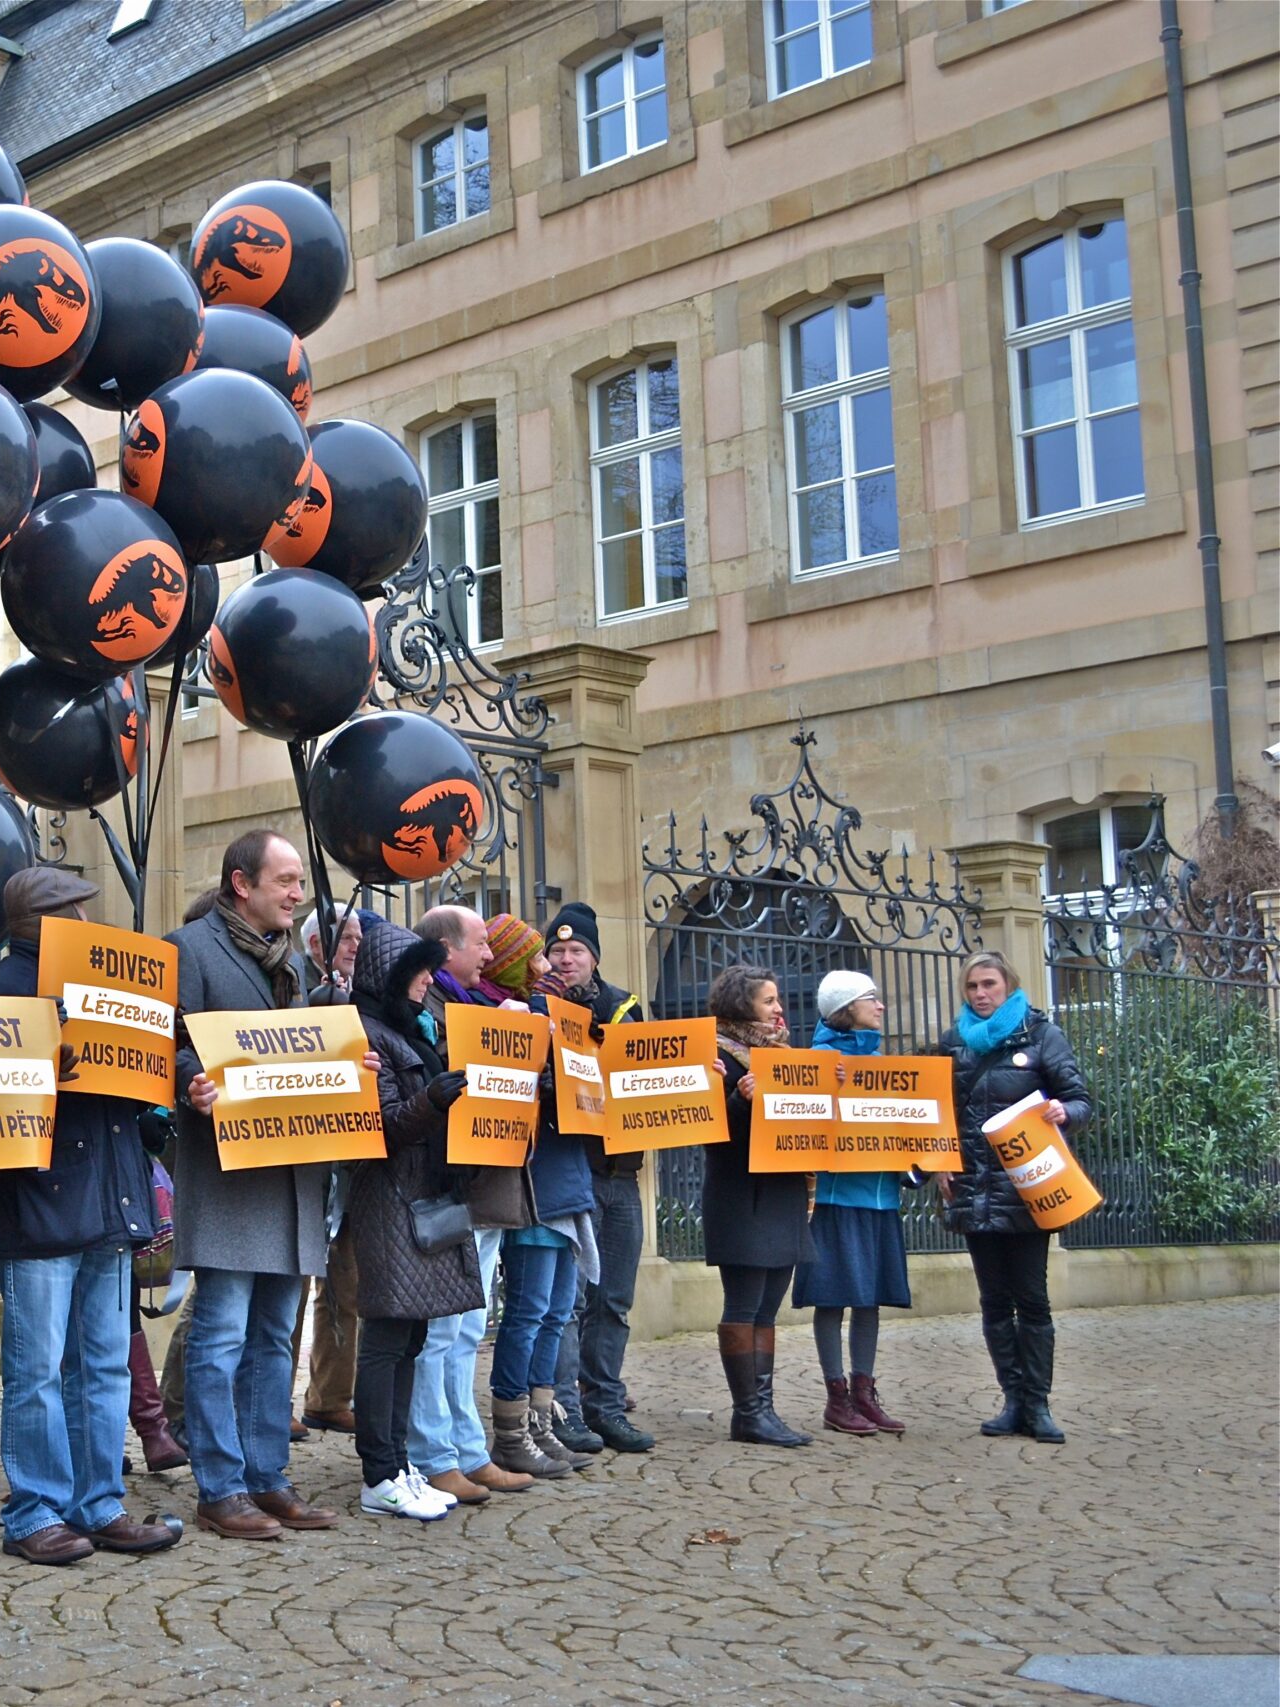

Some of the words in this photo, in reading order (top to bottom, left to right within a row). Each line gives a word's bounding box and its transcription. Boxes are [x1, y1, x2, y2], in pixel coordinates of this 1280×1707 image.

[89, 945, 165, 990] #DIVEST
[81, 992, 170, 1029] LËTZEBUERG
[235, 1026, 326, 1055] #DIVEST
[481, 1027, 533, 1060] #DIVEST
[625, 1036, 688, 1061] #DIVEST
[80, 1041, 114, 1066] AUS
[117, 1046, 143, 1072] DER
[146, 1052, 168, 1079] KUEL
[243, 1070, 346, 1092] LËTZEBUERG
[478, 1071, 533, 1096] LËTZEBUERG
[622, 1074, 696, 1091] LËTZEBUERG
[773, 1064, 819, 1086] #DIVEST
[853, 1070, 919, 1091] #DIVEST
[623, 1112, 644, 1130] AUS
[645, 1109, 670, 1127] DEM
[671, 1104, 714, 1125] PËTROL
[774, 1098, 826, 1114] LËTZEBUERG
[852, 1101, 927, 1118] LËTZEBUERG
[6, 1109, 55, 1139] PËTRO
[218, 1119, 251, 1142] AUS
[253, 1117, 285, 1140] DER
[288, 1111, 383, 1137] ATOMENERGIE
[472, 1117, 492, 1138] AUS
[494, 1119, 510, 1140] DEM
[776, 1135, 793, 1150] AUS
[795, 1135, 809, 1150] DER
[812, 1134, 828, 1150] KUEL
[857, 1136, 879, 1151] DER
[883, 1136, 959, 1152] ATOMENERGIE
[1034, 1187, 1072, 1213] KUEL
